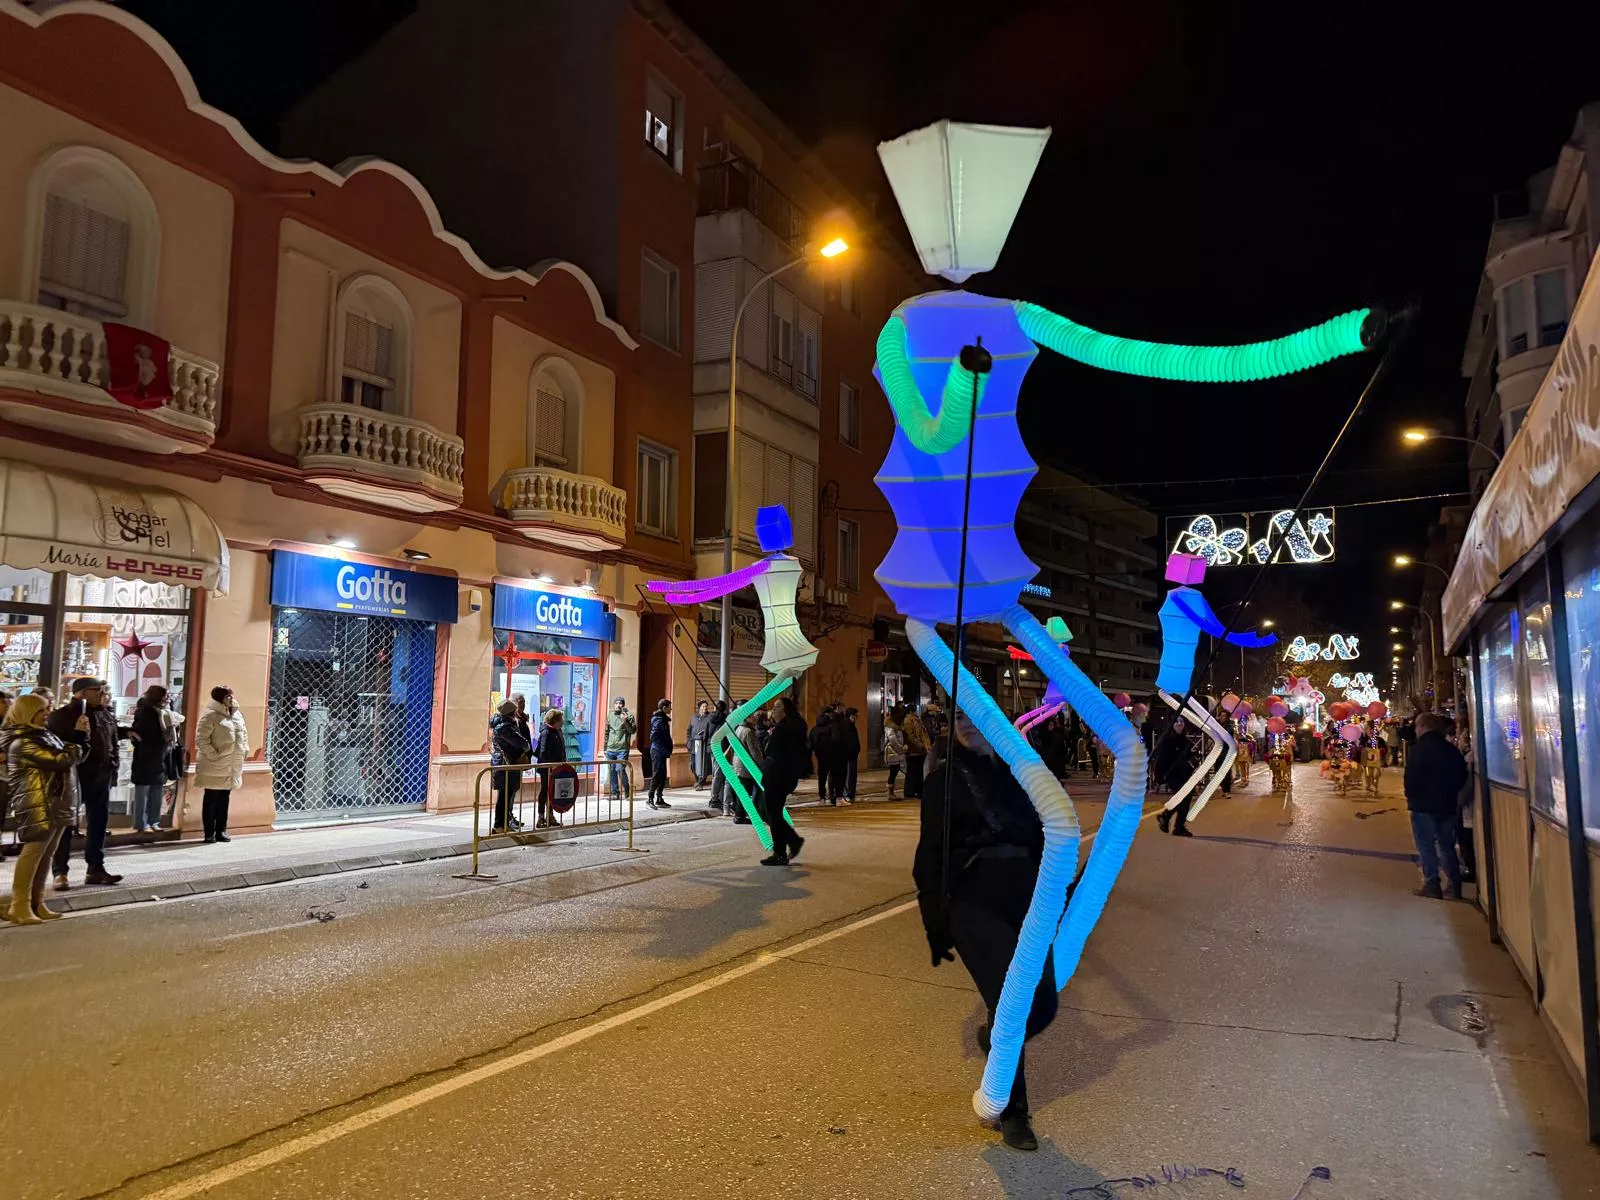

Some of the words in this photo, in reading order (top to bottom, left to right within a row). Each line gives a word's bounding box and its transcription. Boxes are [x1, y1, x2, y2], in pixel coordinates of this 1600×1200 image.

[112, 505, 167, 528] Hogar
[40, 545, 103, 569] María
[336, 565, 407, 606] Gotta
[536, 594, 583, 627] Gotta
